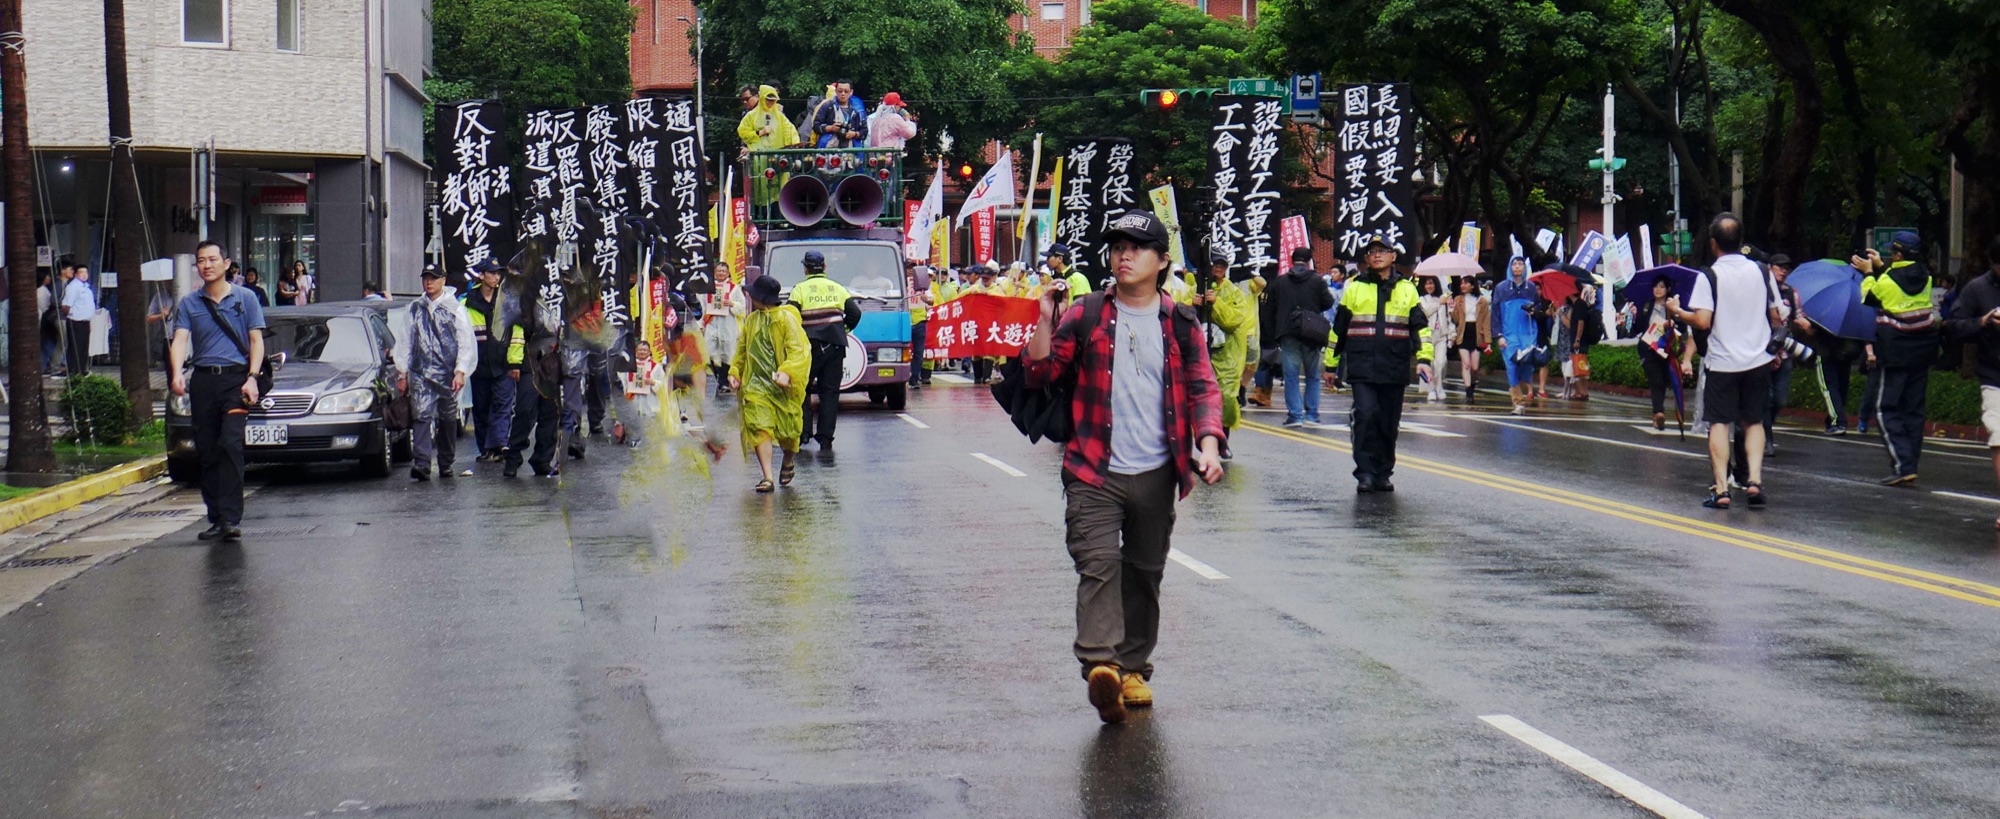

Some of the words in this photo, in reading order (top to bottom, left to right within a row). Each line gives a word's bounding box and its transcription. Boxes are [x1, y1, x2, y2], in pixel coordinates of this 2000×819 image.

[1243, 101, 1283, 277] 設勞工董事
[1338, 84, 1372, 257] 國假要增加
[1370, 84, 1406, 254] 長照要入法
